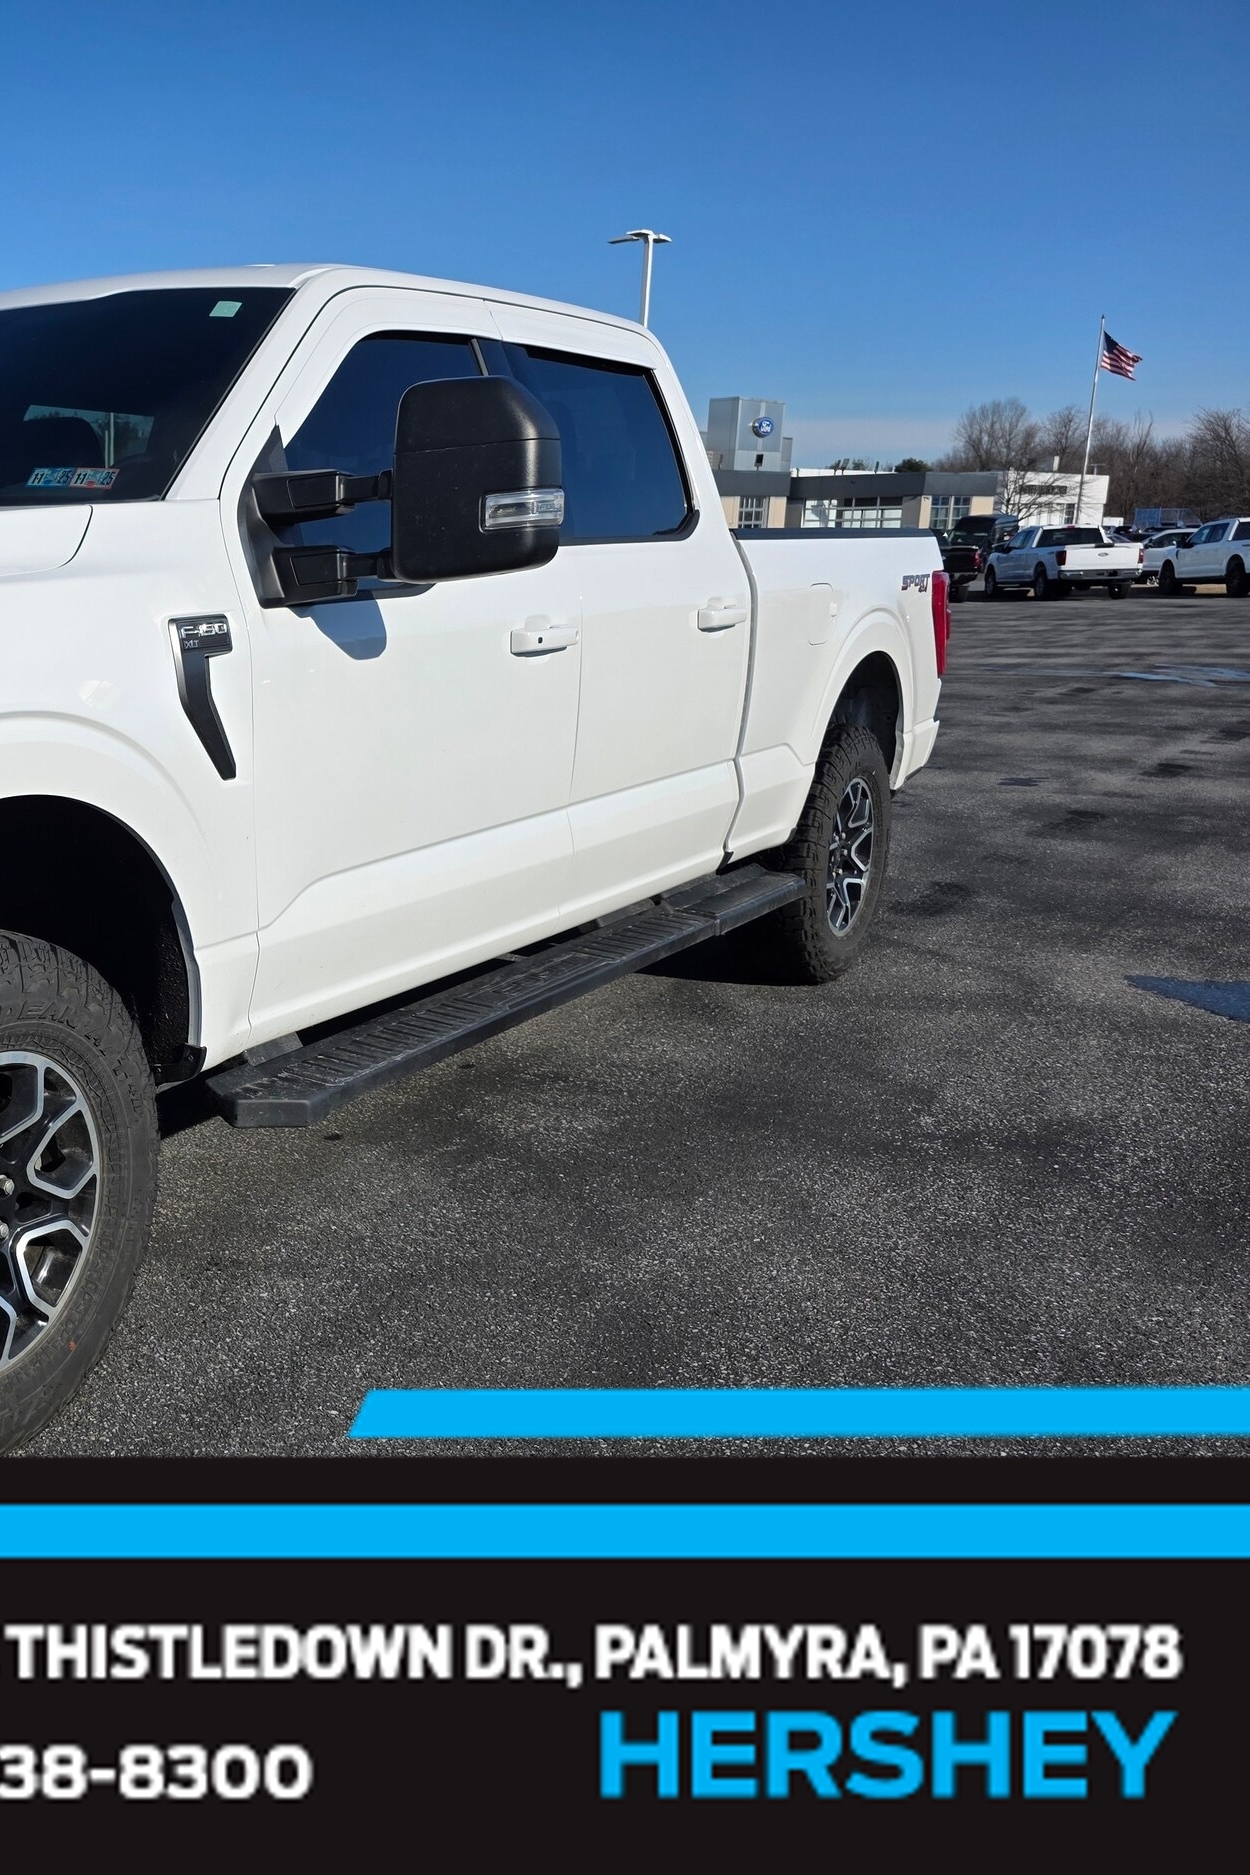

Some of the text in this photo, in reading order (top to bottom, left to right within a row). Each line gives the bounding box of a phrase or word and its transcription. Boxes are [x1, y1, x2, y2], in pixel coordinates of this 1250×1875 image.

[32, 470, 73, 485] 11 25
[74, 471, 116, 486] 11 25
[184, 639, 200, 649] XLT
